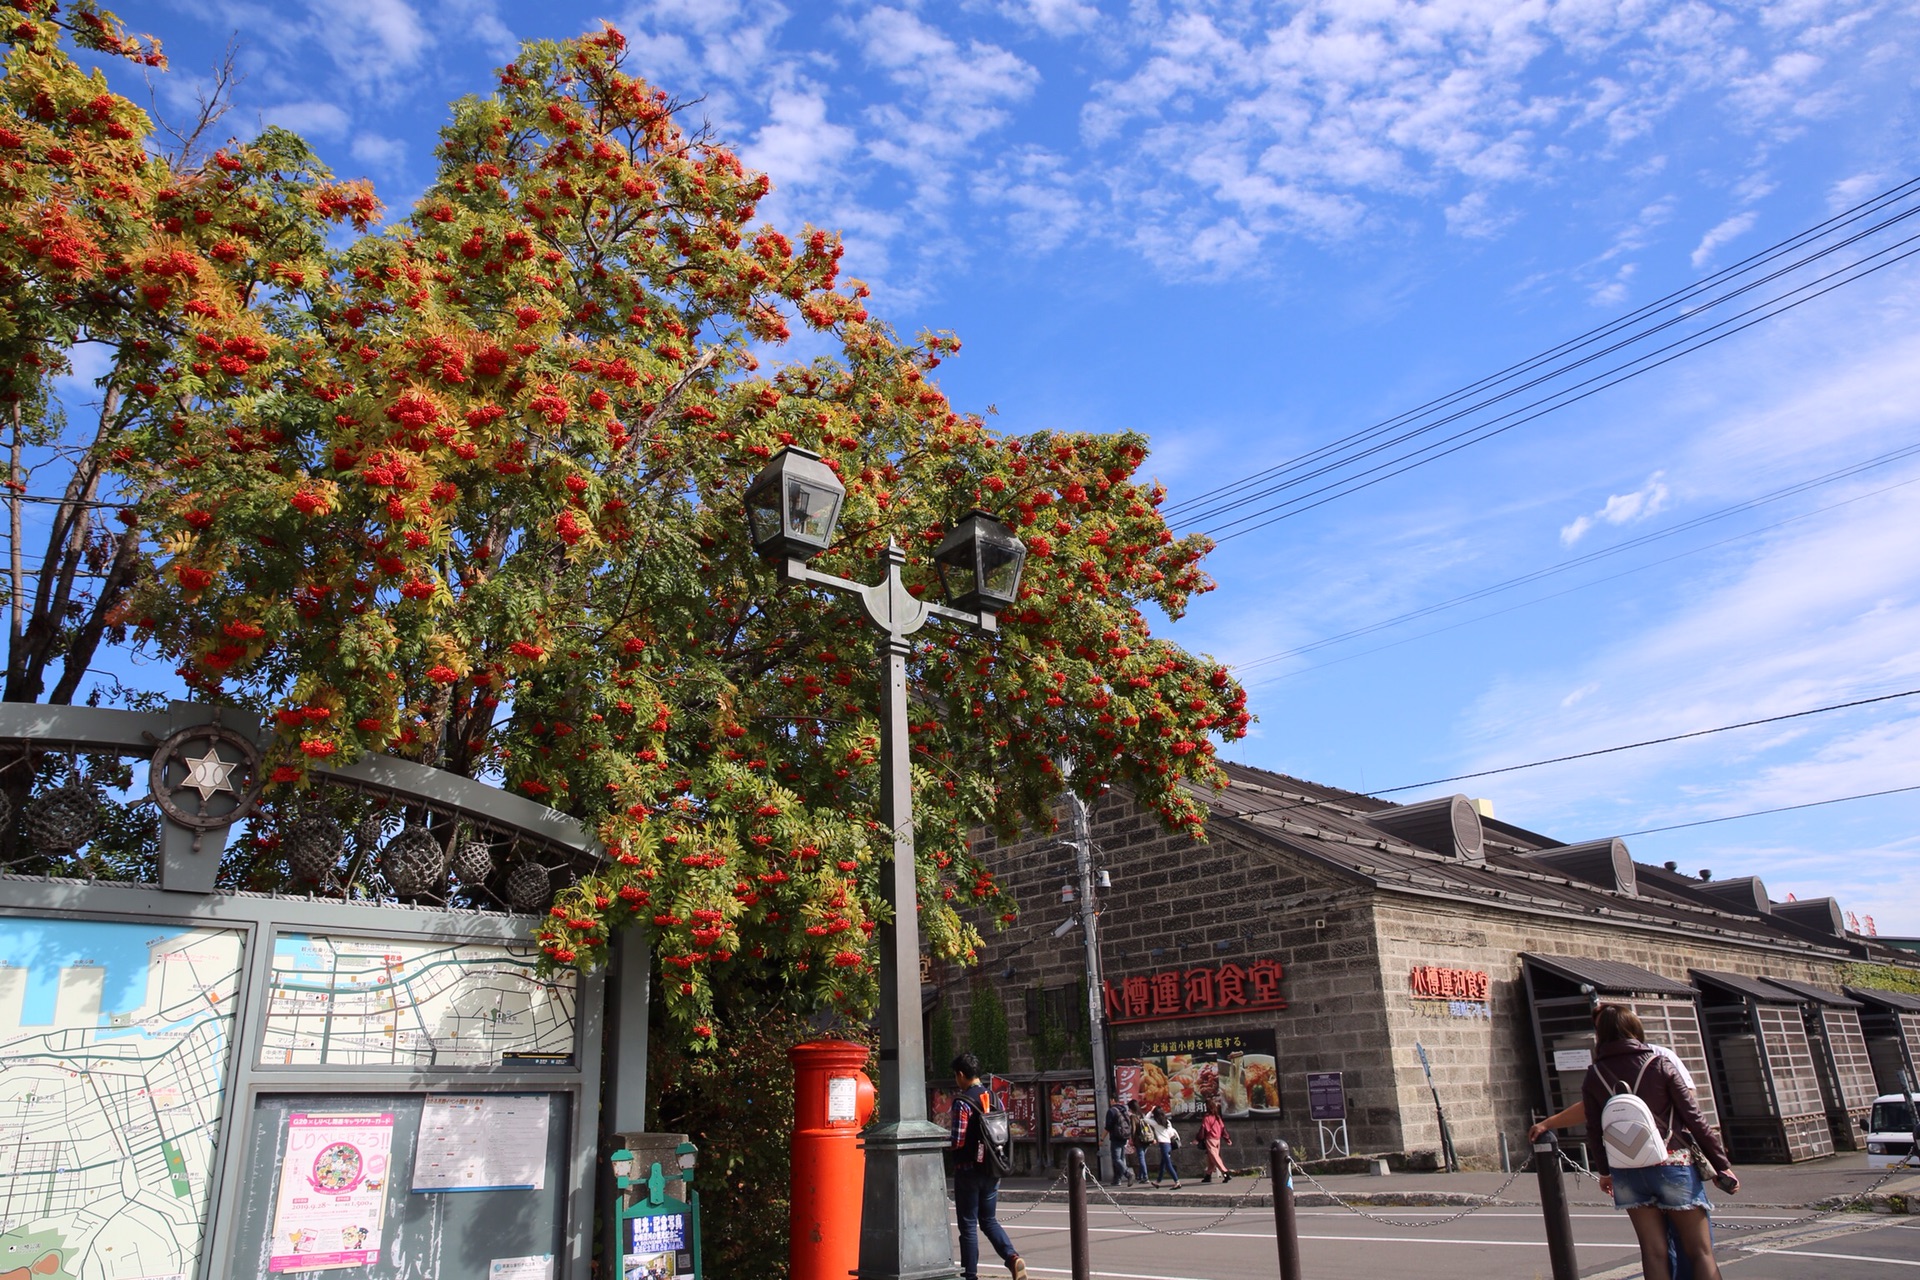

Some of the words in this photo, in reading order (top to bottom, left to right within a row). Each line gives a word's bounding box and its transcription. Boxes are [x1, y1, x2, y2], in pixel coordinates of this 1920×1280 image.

[1104, 960, 1285, 1018] 小樽運河食堂
[1412, 966, 1490, 998] 小樽運河食堂
[1152, 1036, 1246, 1053] 北海道小樽を堪能する。
[1174, 1102, 1208, 1114] 小樽運河
